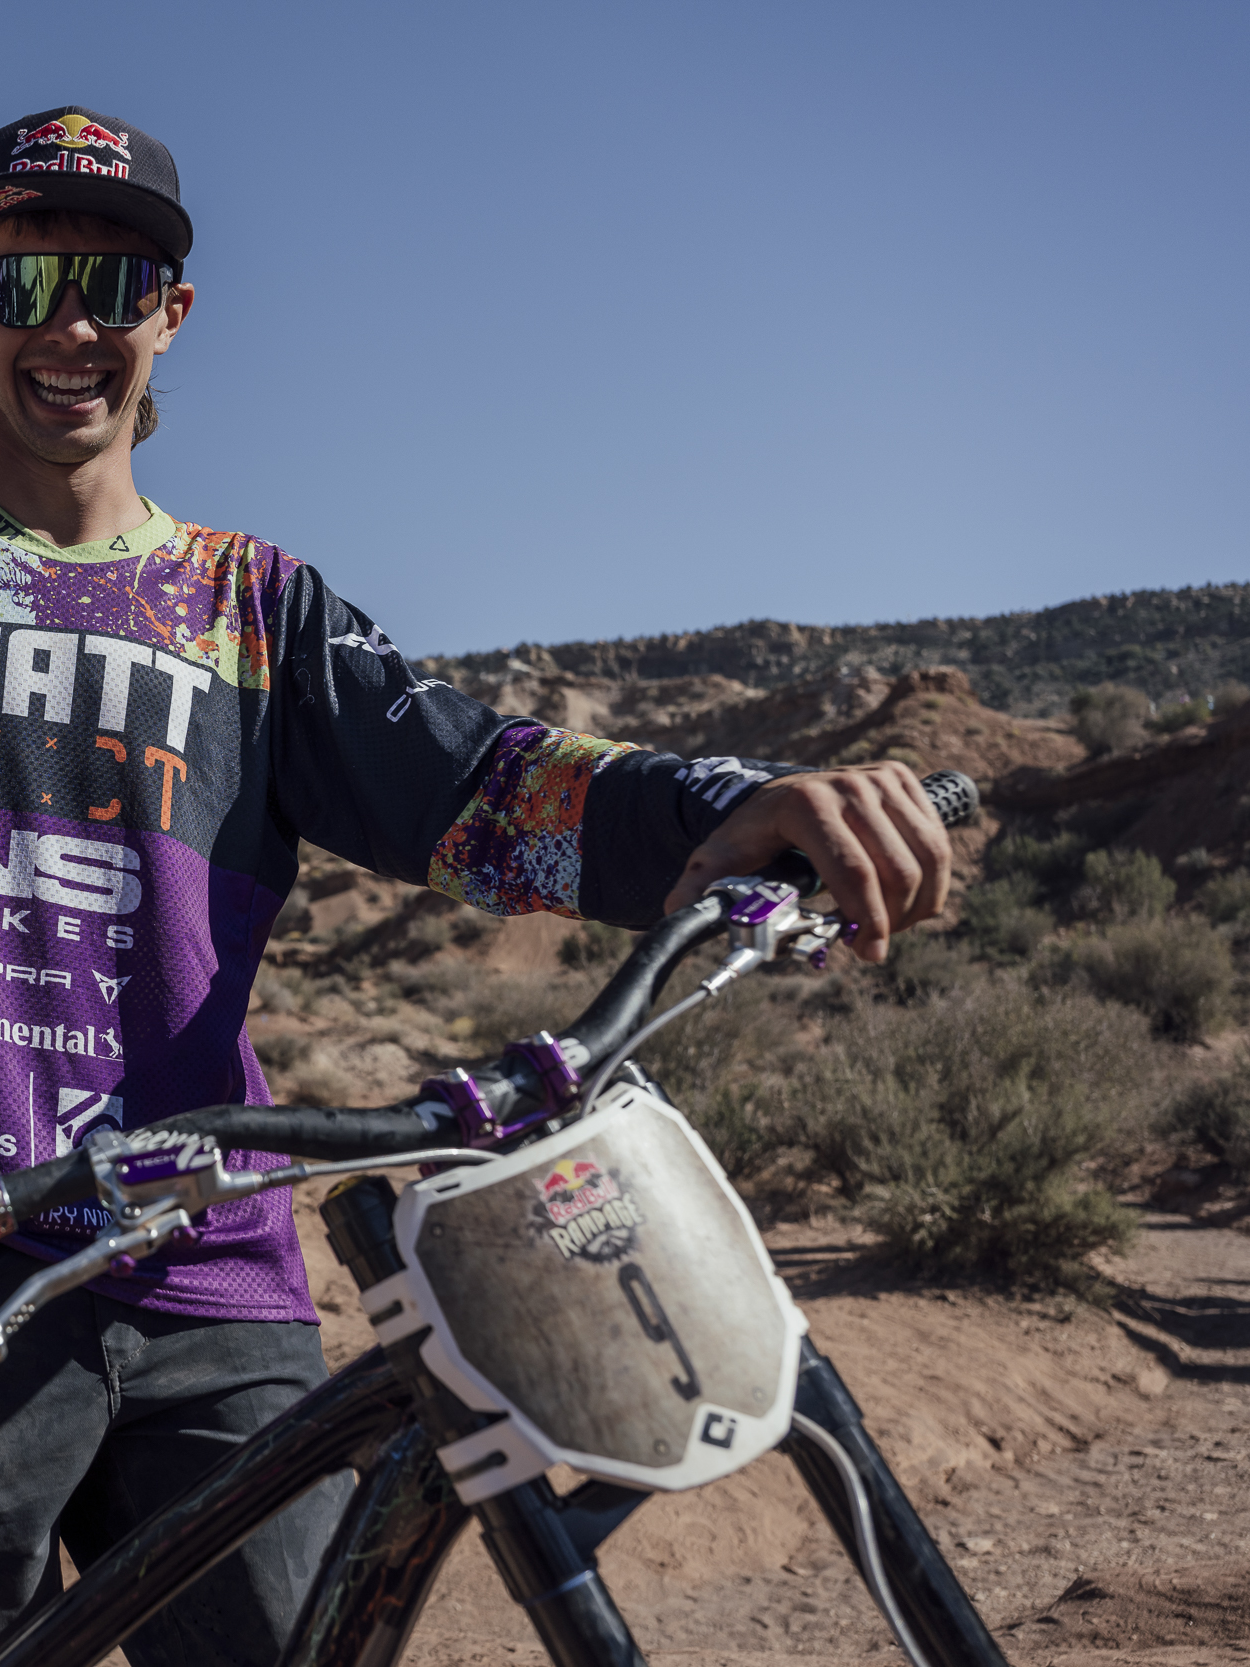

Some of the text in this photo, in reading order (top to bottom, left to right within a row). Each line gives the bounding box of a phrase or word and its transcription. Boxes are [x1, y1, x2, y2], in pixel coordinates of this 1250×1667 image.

[547, 1176, 619, 1224] Red Bull
[550, 1193, 644, 1259] RAMPAGE
[618, 1262, 701, 1401] 9
